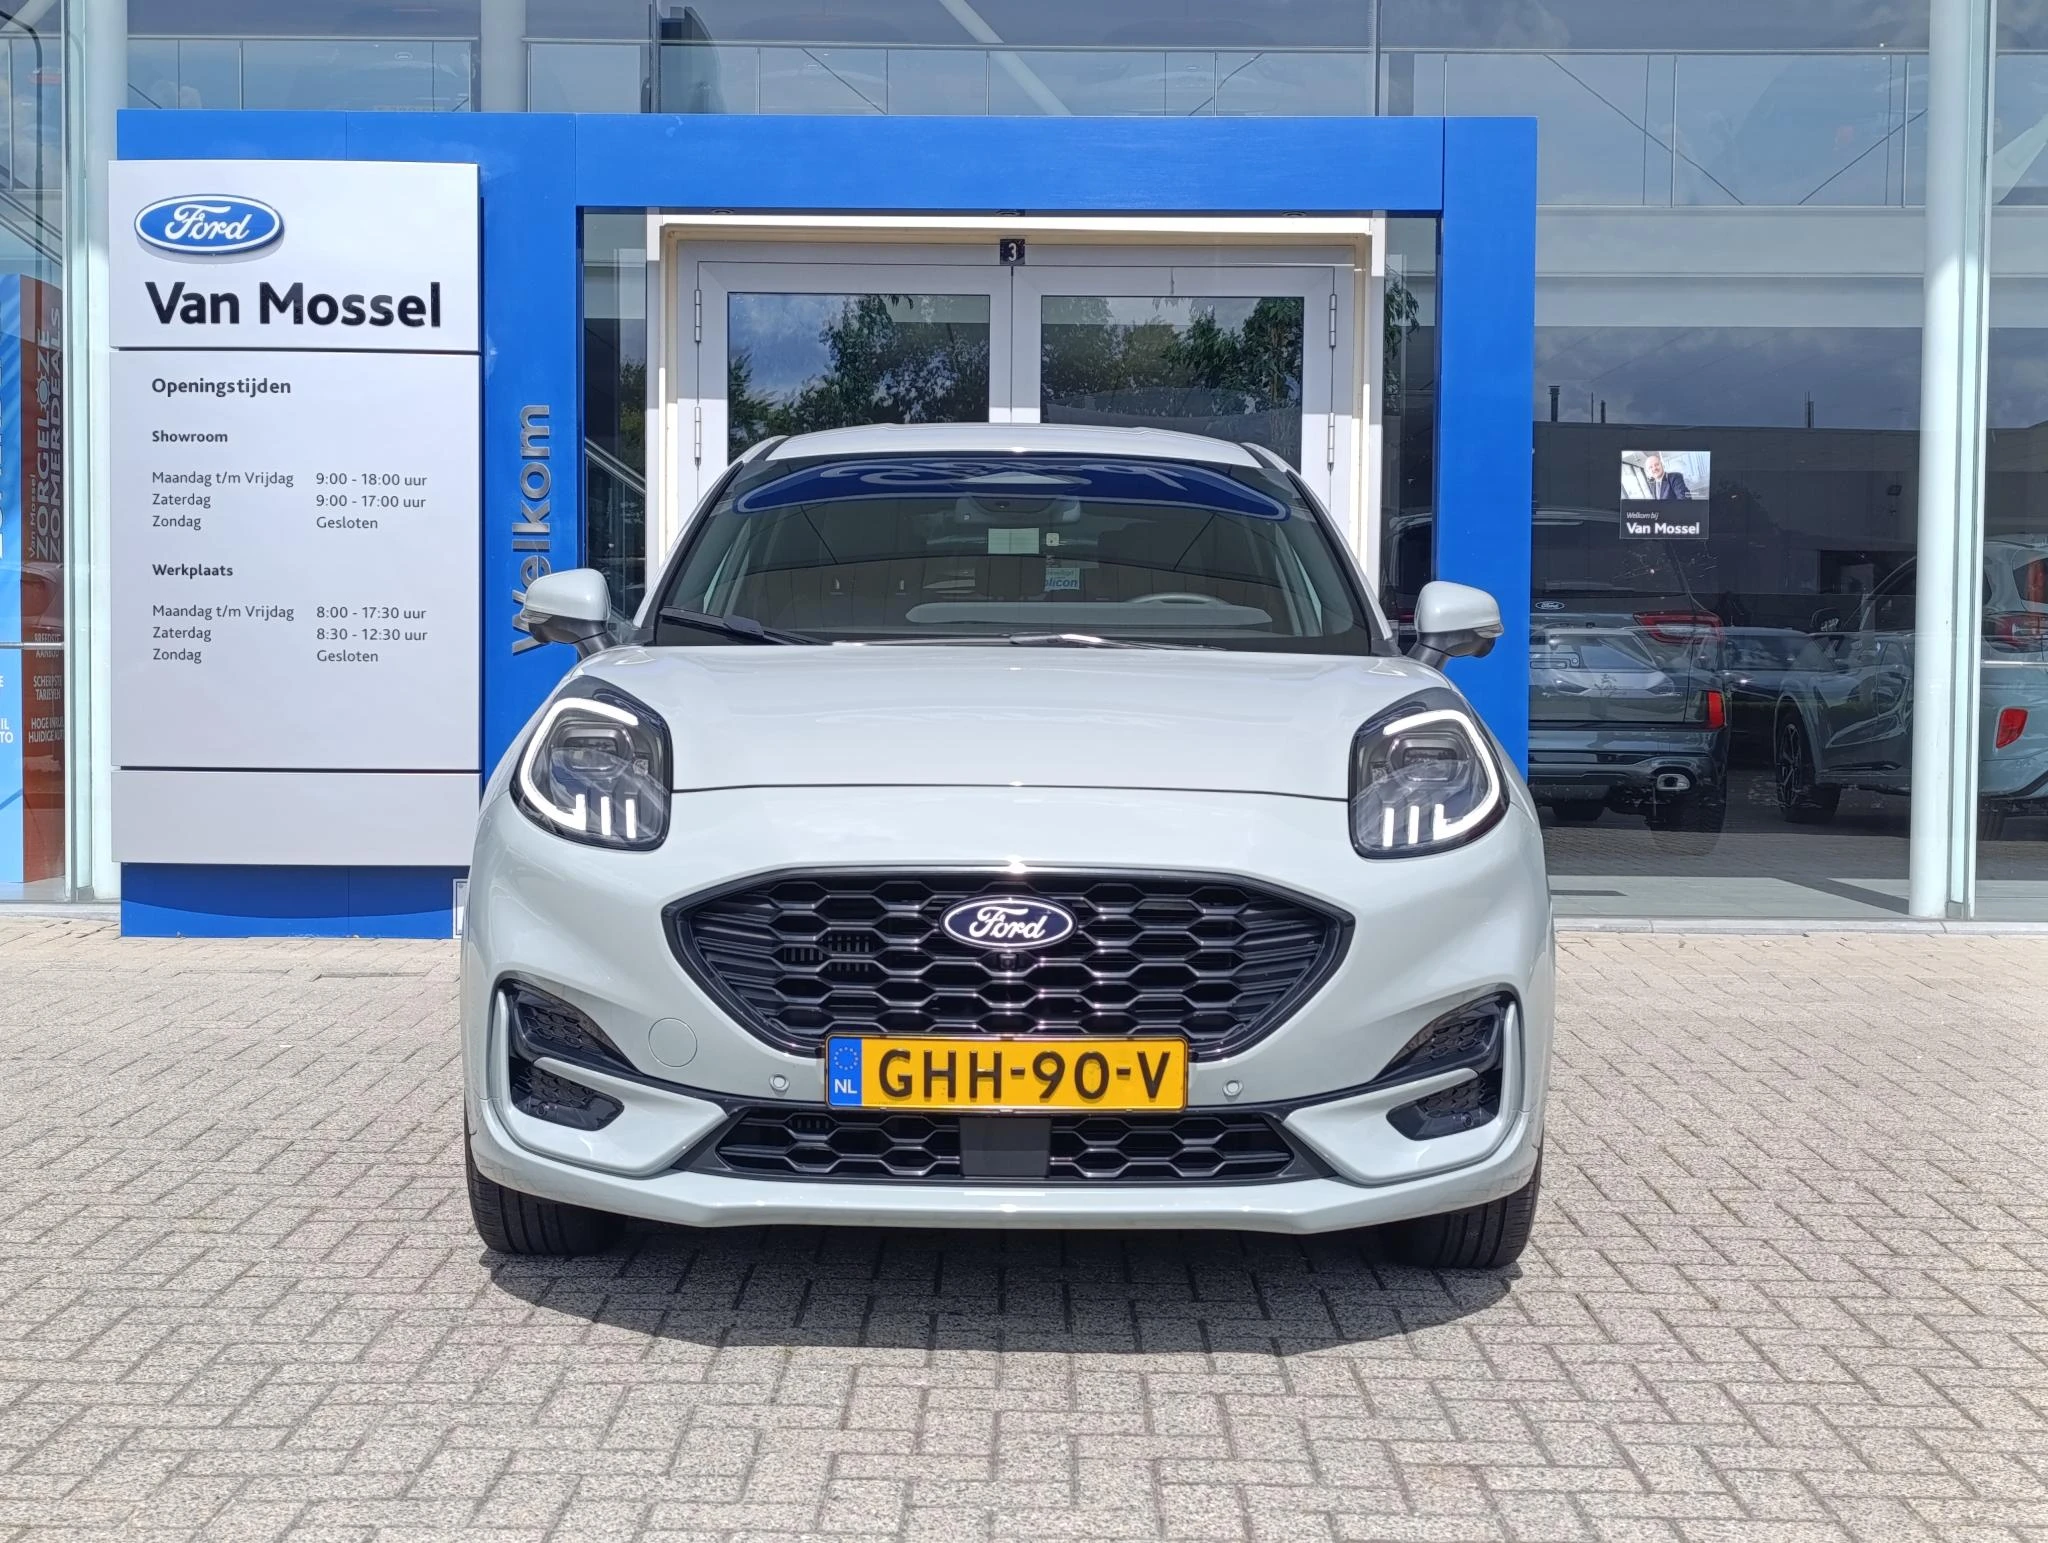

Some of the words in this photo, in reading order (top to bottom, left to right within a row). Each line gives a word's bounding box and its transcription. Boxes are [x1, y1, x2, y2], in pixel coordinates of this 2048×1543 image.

[164, 203, 252, 240] Ford
[1008, 242, 1017, 261] 3
[144, 281, 240, 325] Van
[259, 281, 441, 328] Mossel
[151, 377, 292, 398] Openingstijden
[50, 307, 61, 562] ZOMERDEALS
[151, 430, 229, 443] Showroom
[152, 471, 212, 487] Maandag
[216, 471, 241, 484] t/m
[244, 471, 294, 488] Vrijdag
[316, 472, 347, 486] 9:00
[361, 473, 401, 486] 18:00
[404, 476, 428, 487] uur
[152, 493, 211, 509] Zaterdag
[316, 494, 347, 507] 9:00
[361, 495, 399, 508] 17:00
[402, 498, 427, 508] uur
[152, 515, 202, 531] Zondag
[316, 516, 378, 529] Gesloten
[1626, 511, 1650, 519] Welkom
[1650, 511, 1660, 520] bij
[1626, 522, 1651, 534] Van
[1654, 521, 1700, 534] Mossel
[152, 563, 234, 579] Werkplaats
[152, 605, 212, 621] Maandag
[216, 605, 241, 618] t/m
[245, 605, 295, 622] Vrijdag
[316, 606, 348, 619] 8:00
[361, 607, 400, 619] 17:30
[403, 609, 427, 619] uur
[152, 627, 212, 642] Zaterdag
[316, 627, 348, 640] 8:30
[361, 628, 401, 641] 12:30
[404, 631, 428, 641] uur
[152, 648, 202, 664] Zondag
[316, 649, 379, 662] Gesloten
[32, 716, 49, 729] HOGE
[968, 906, 1049, 939] Ford
[834, 1079, 858, 1094] NL
[879, 1048, 1171, 1101] GHH-90-V
